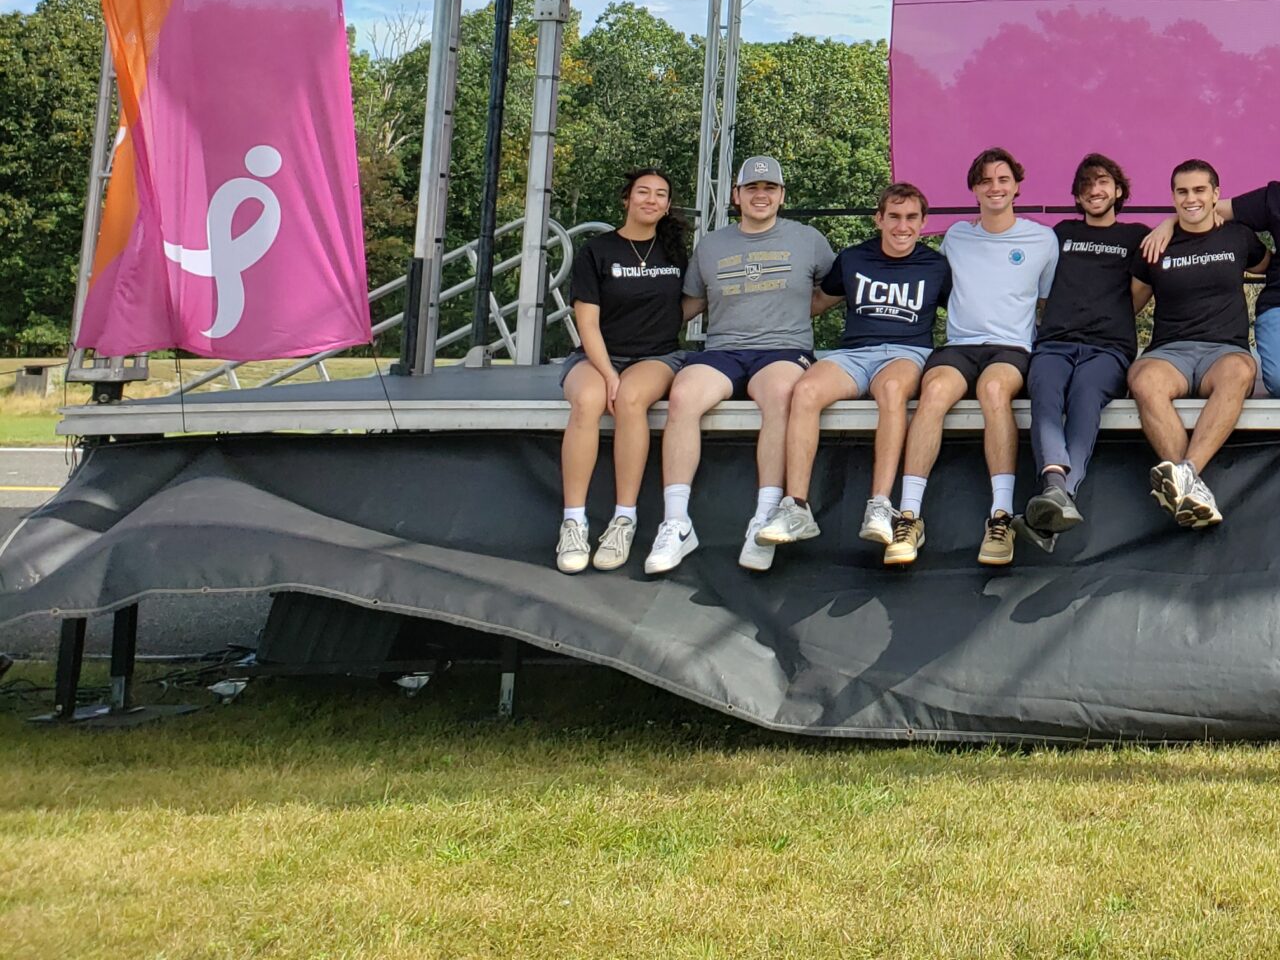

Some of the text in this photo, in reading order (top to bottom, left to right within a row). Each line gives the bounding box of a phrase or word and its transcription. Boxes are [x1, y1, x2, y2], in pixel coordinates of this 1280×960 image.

[1072, 241, 1127, 258] TCNJ Engineering
[1172, 251, 1235, 268] TCNJ Engineering
[622, 265, 680, 278] TCNJ Engineering
[855, 272, 925, 311] TCNJ
